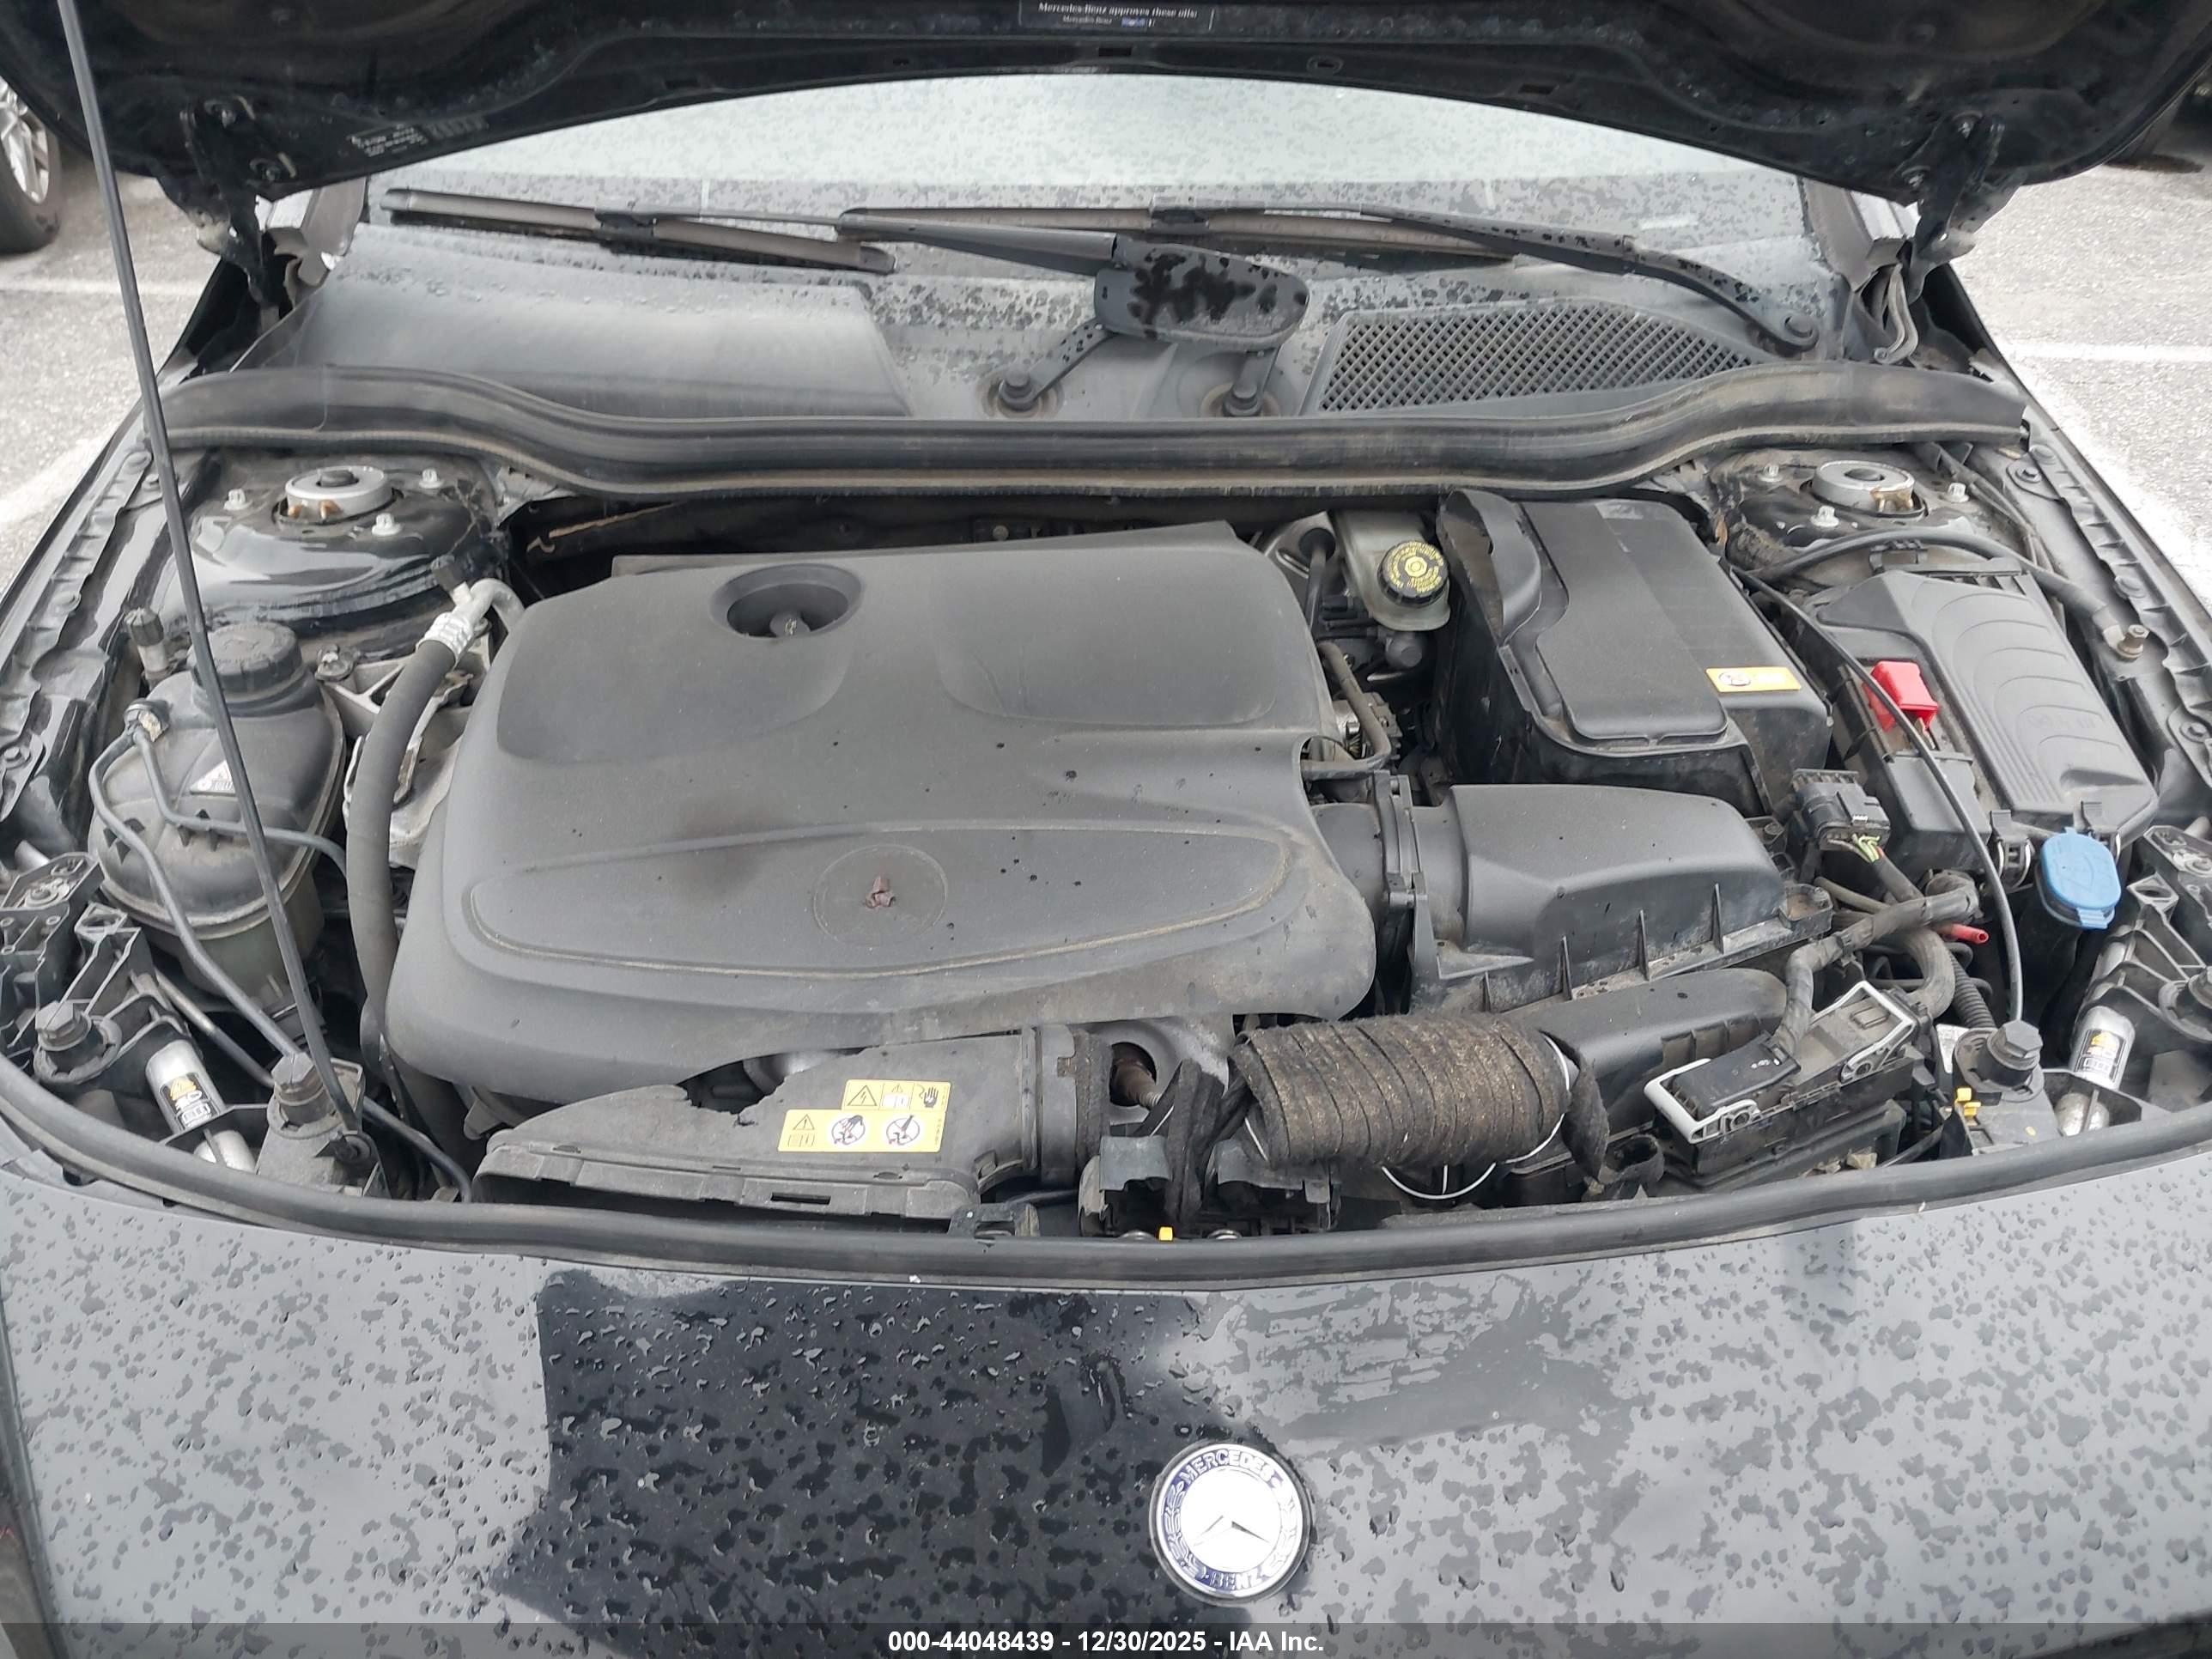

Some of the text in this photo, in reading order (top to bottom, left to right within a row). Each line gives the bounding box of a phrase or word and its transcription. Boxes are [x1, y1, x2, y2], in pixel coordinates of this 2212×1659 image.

[1109, 6, 1150, 17] approves
[1152, 6, 1176, 17] these
[1179, 1448, 1274, 1483] MERCEDES
[1209, 1571, 1263, 1589] BENZ
